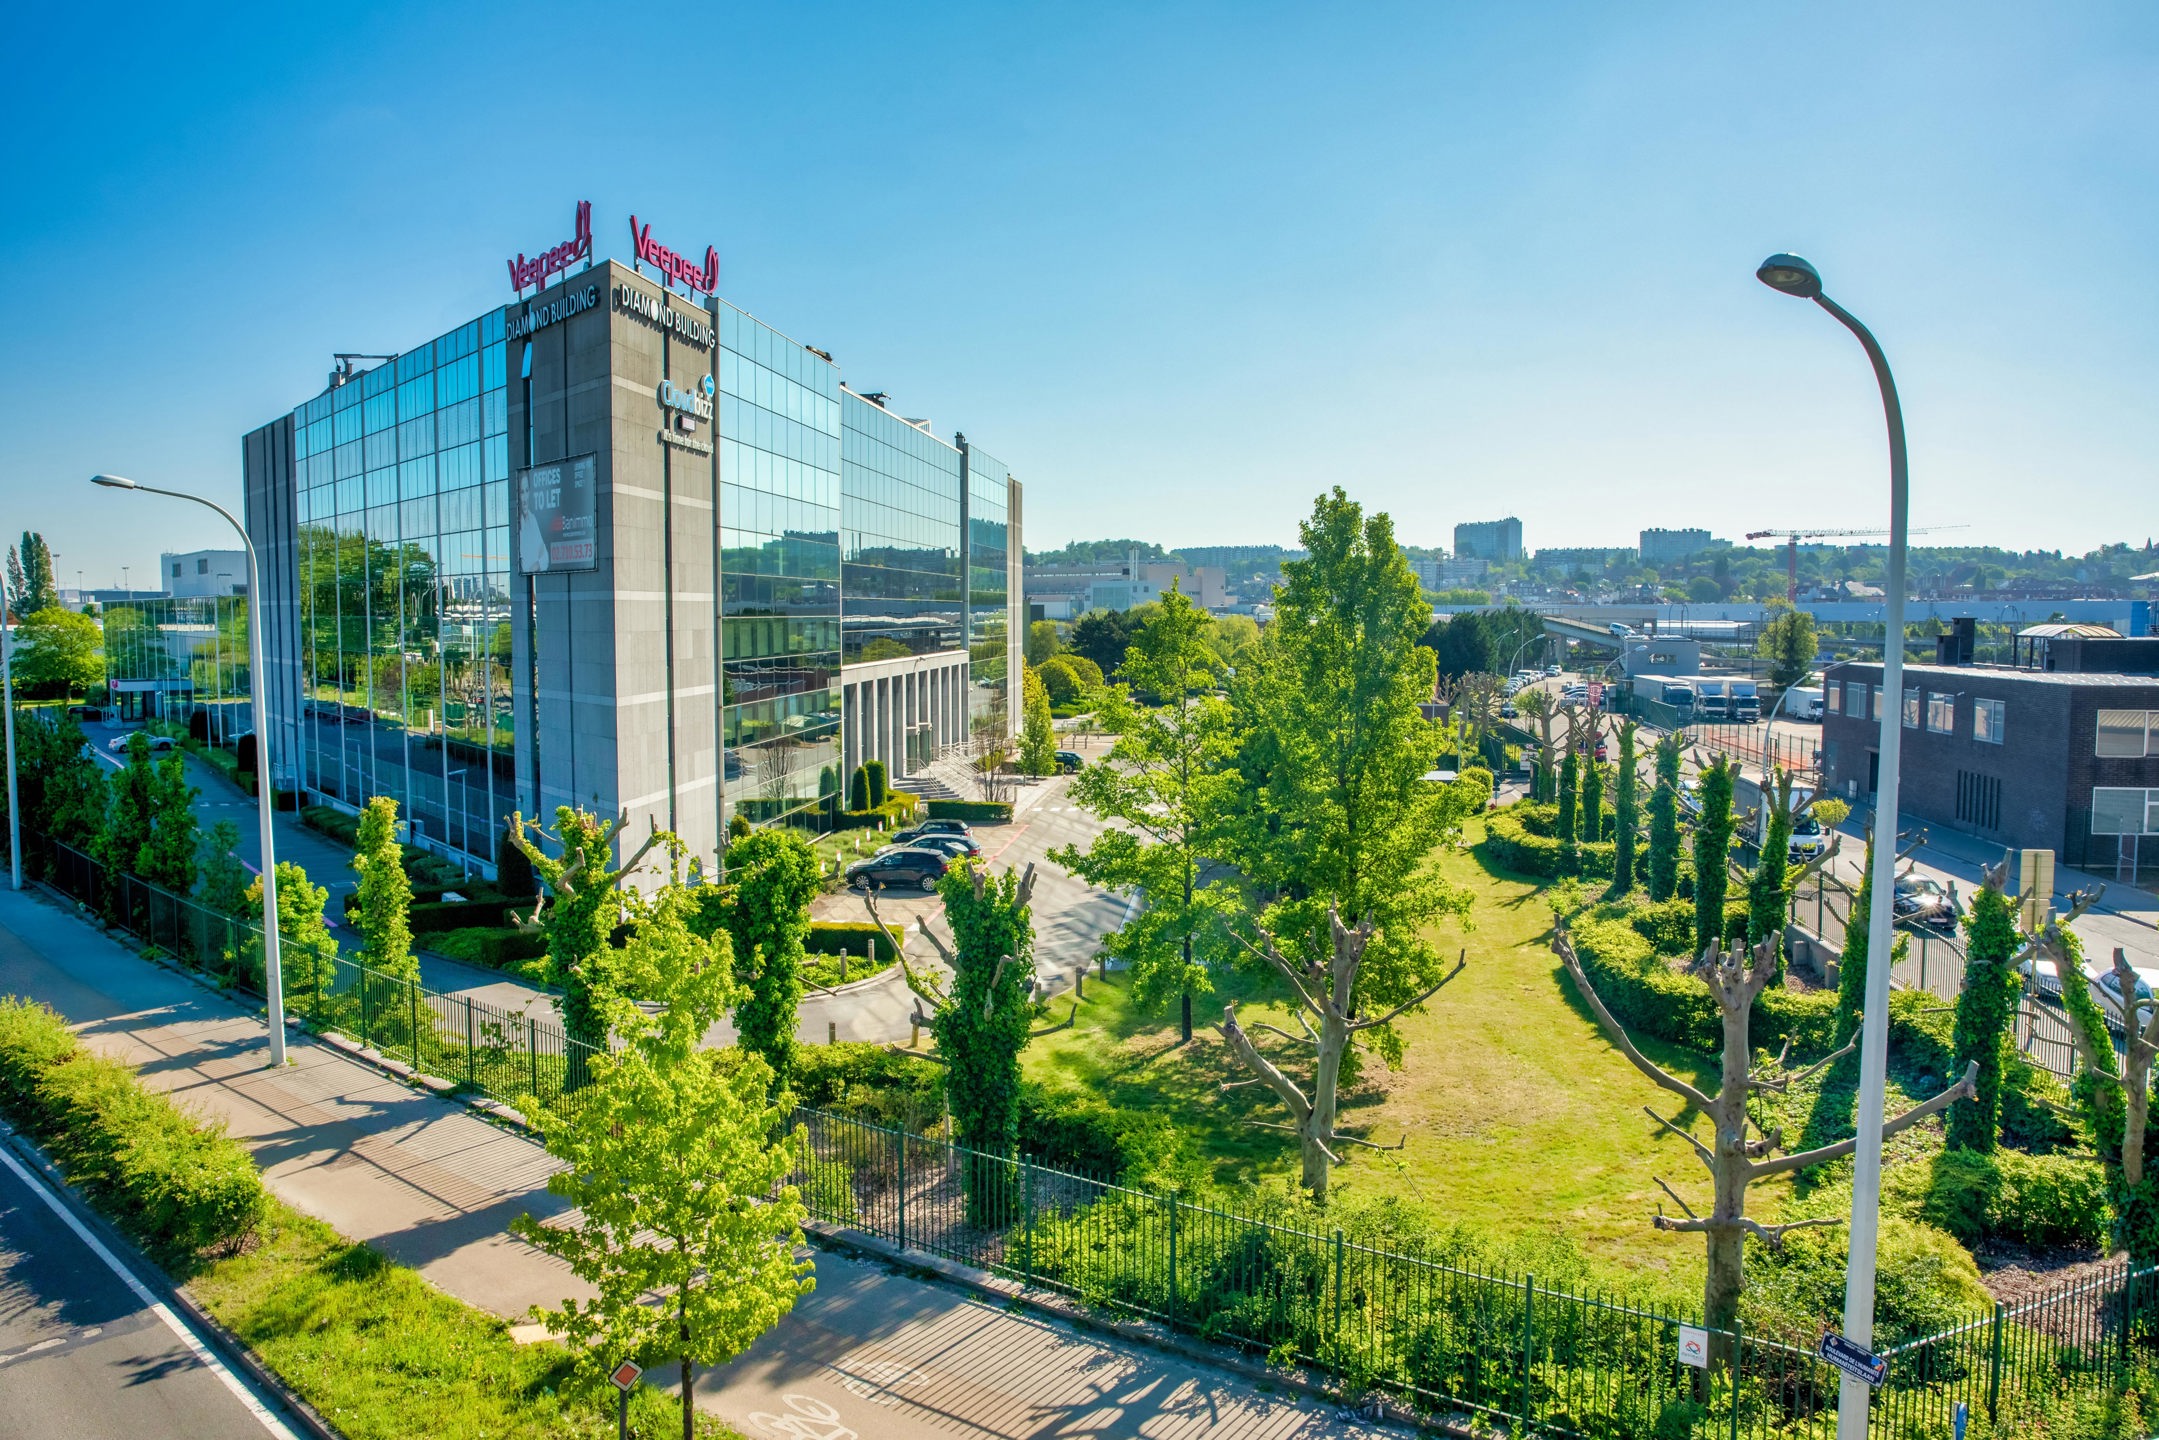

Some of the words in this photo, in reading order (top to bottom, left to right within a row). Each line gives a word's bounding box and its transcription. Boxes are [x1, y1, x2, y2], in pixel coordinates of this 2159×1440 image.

[630, 215, 718, 296] Veepee
[506, 304, 549, 342] DIAMOND
[551, 285, 596, 322] BUILDING
[622, 284, 673, 328] DIAMOND
[675, 314, 716, 349] BUILDING
[533, 468, 561, 487] OFFICES
[533, 491, 545, 510] TO
[546, 488, 561, 509] LET
[1825, 1345, 1849, 1361] BOULEVARD
[1826, 1352, 1875, 1382] HUMANITEITSLAAN
